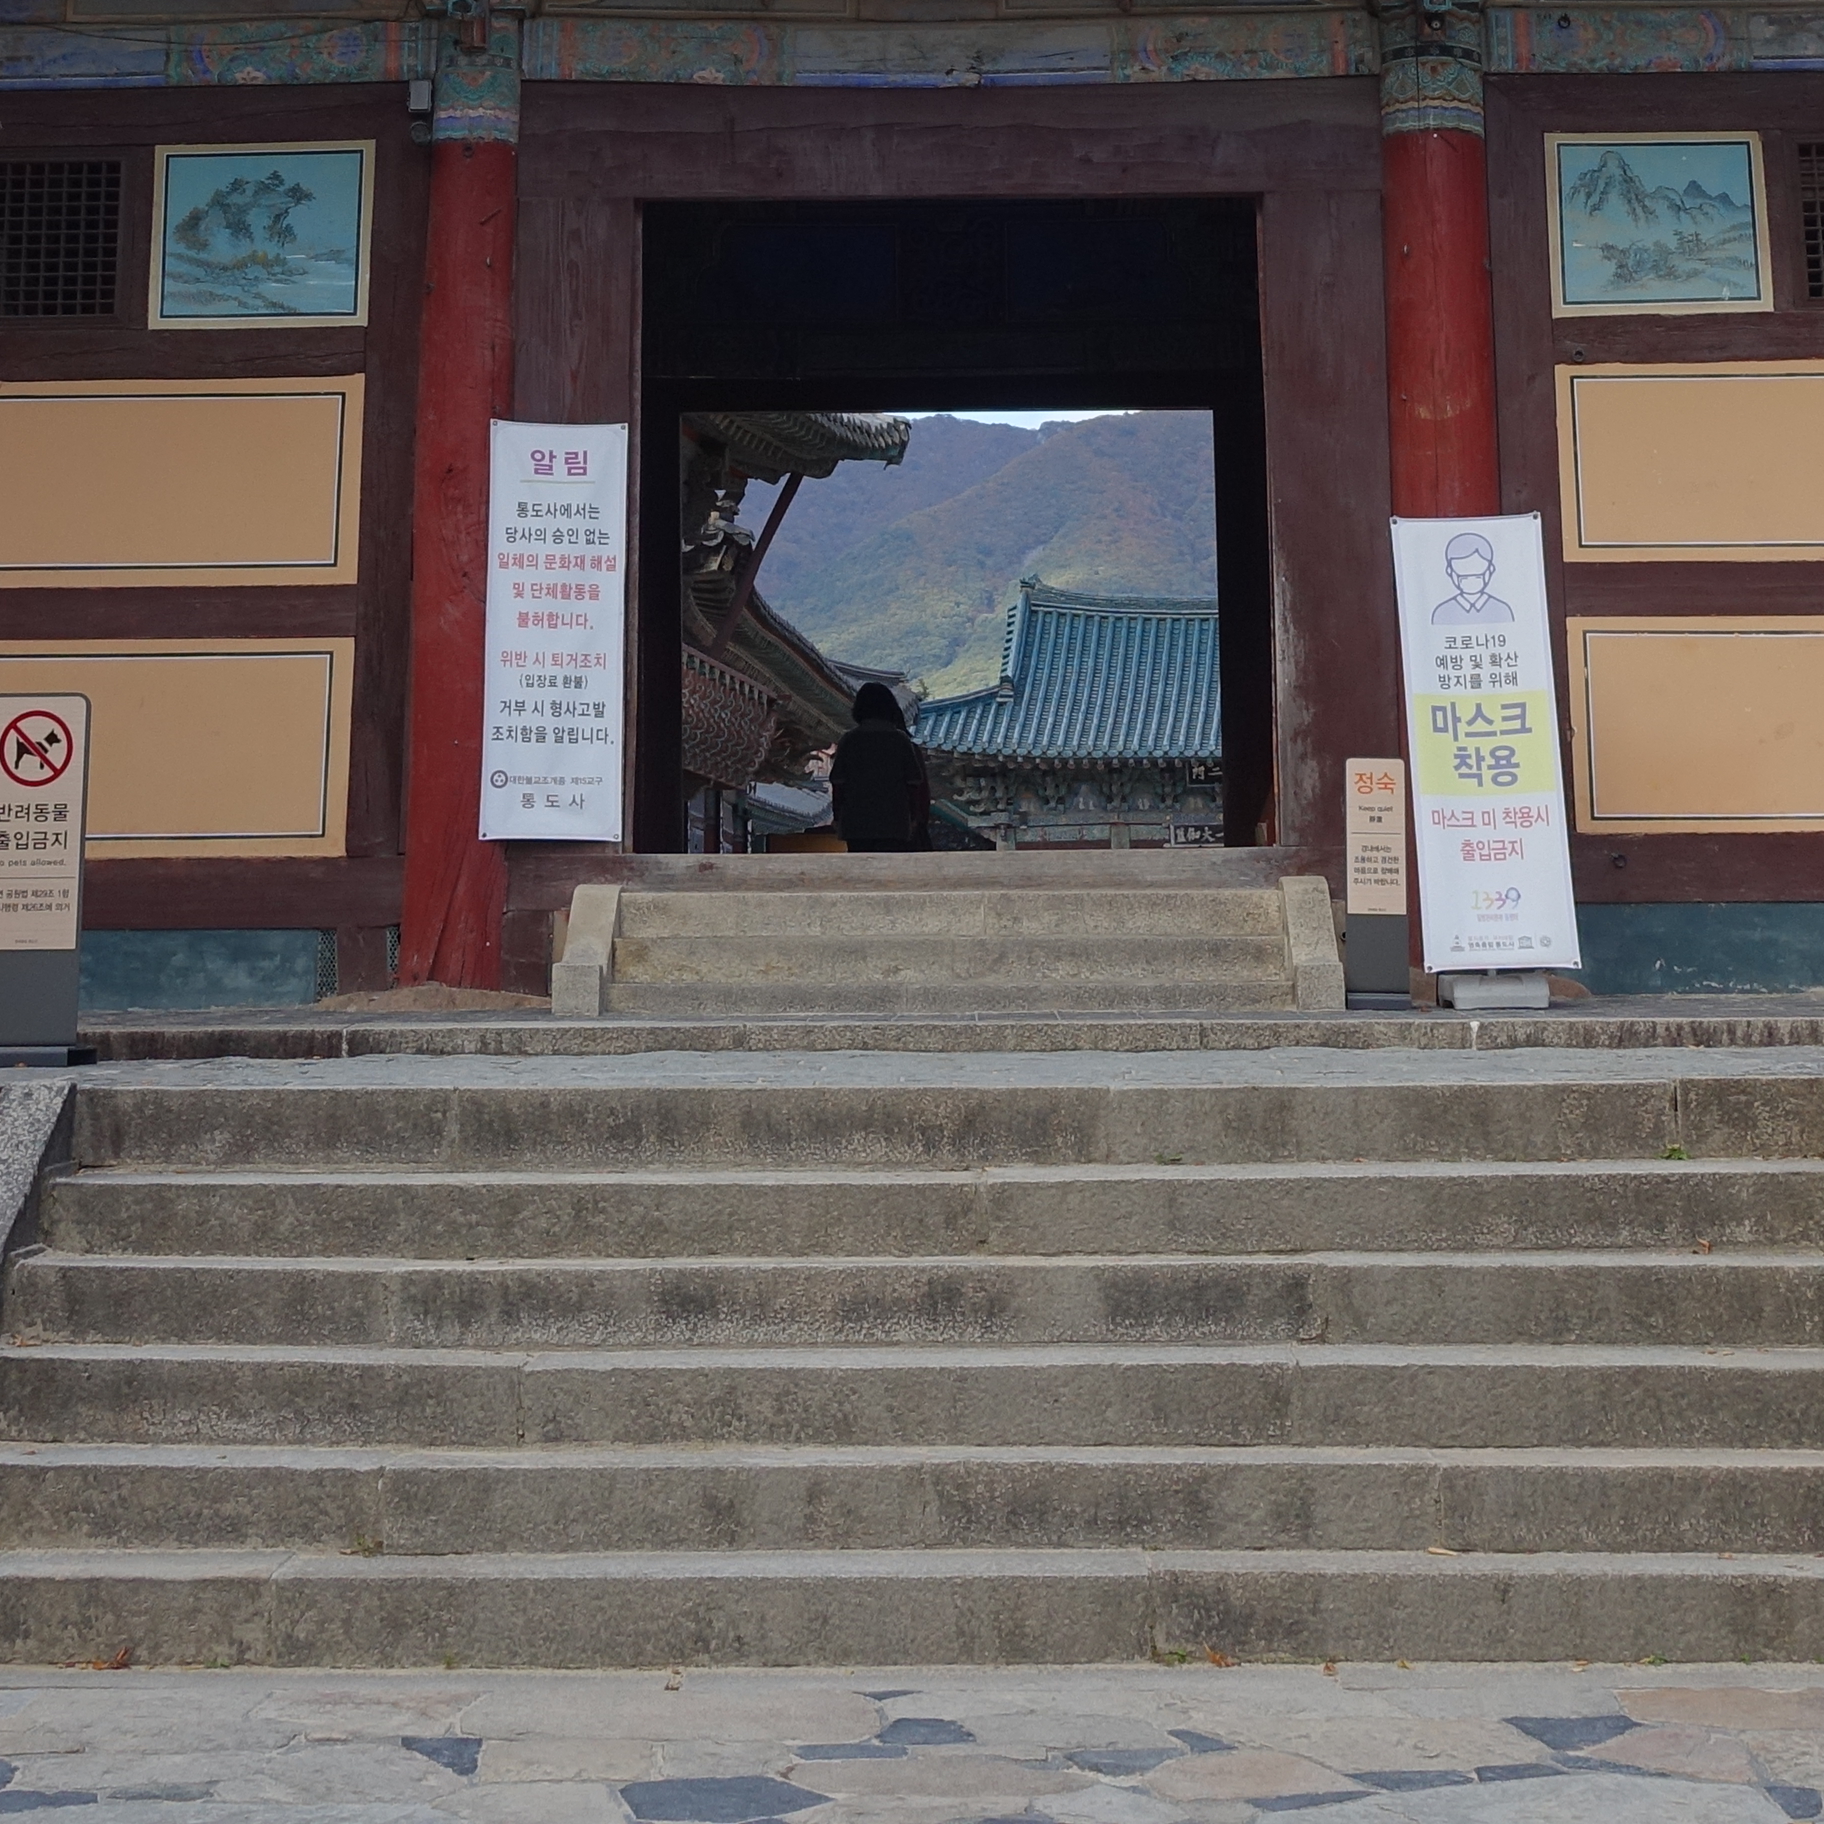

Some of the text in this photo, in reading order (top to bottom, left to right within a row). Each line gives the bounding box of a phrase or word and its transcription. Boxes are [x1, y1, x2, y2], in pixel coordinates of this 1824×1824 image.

[516, 501, 600, 520] 통도사에서는
[505, 526, 610, 546] 당사의 승인 없는
[497, 552, 617, 572] 일체의 문화재 해설
[512, 581, 601, 601] 및 단체활동을
[517, 611, 594, 630] 불허합니다.
[1444, 633, 1507, 650] 코로나19
[500, 650, 607, 670] 위반 시 퇴거조치
[1435, 651, 1519, 671] 예방 및 확산
[519, 673, 588, 690] (입장료 환불)
[1438, 670, 1519, 690] 방지를 위해
[499, 699, 606, 718] 거부 시 형사고발
[1430, 701, 1533, 742] 마스크
[491, 725, 615, 745] 조치함을 알립니다.
[1452, 745, 1521, 788] 착용
[1354, 771, 1397, 795] 정숙
[1431, 804, 1550, 830] 마스크 미 착용시
[1460, 838, 1524, 862] 출입금지
[8, 859, 27, 867] pets
